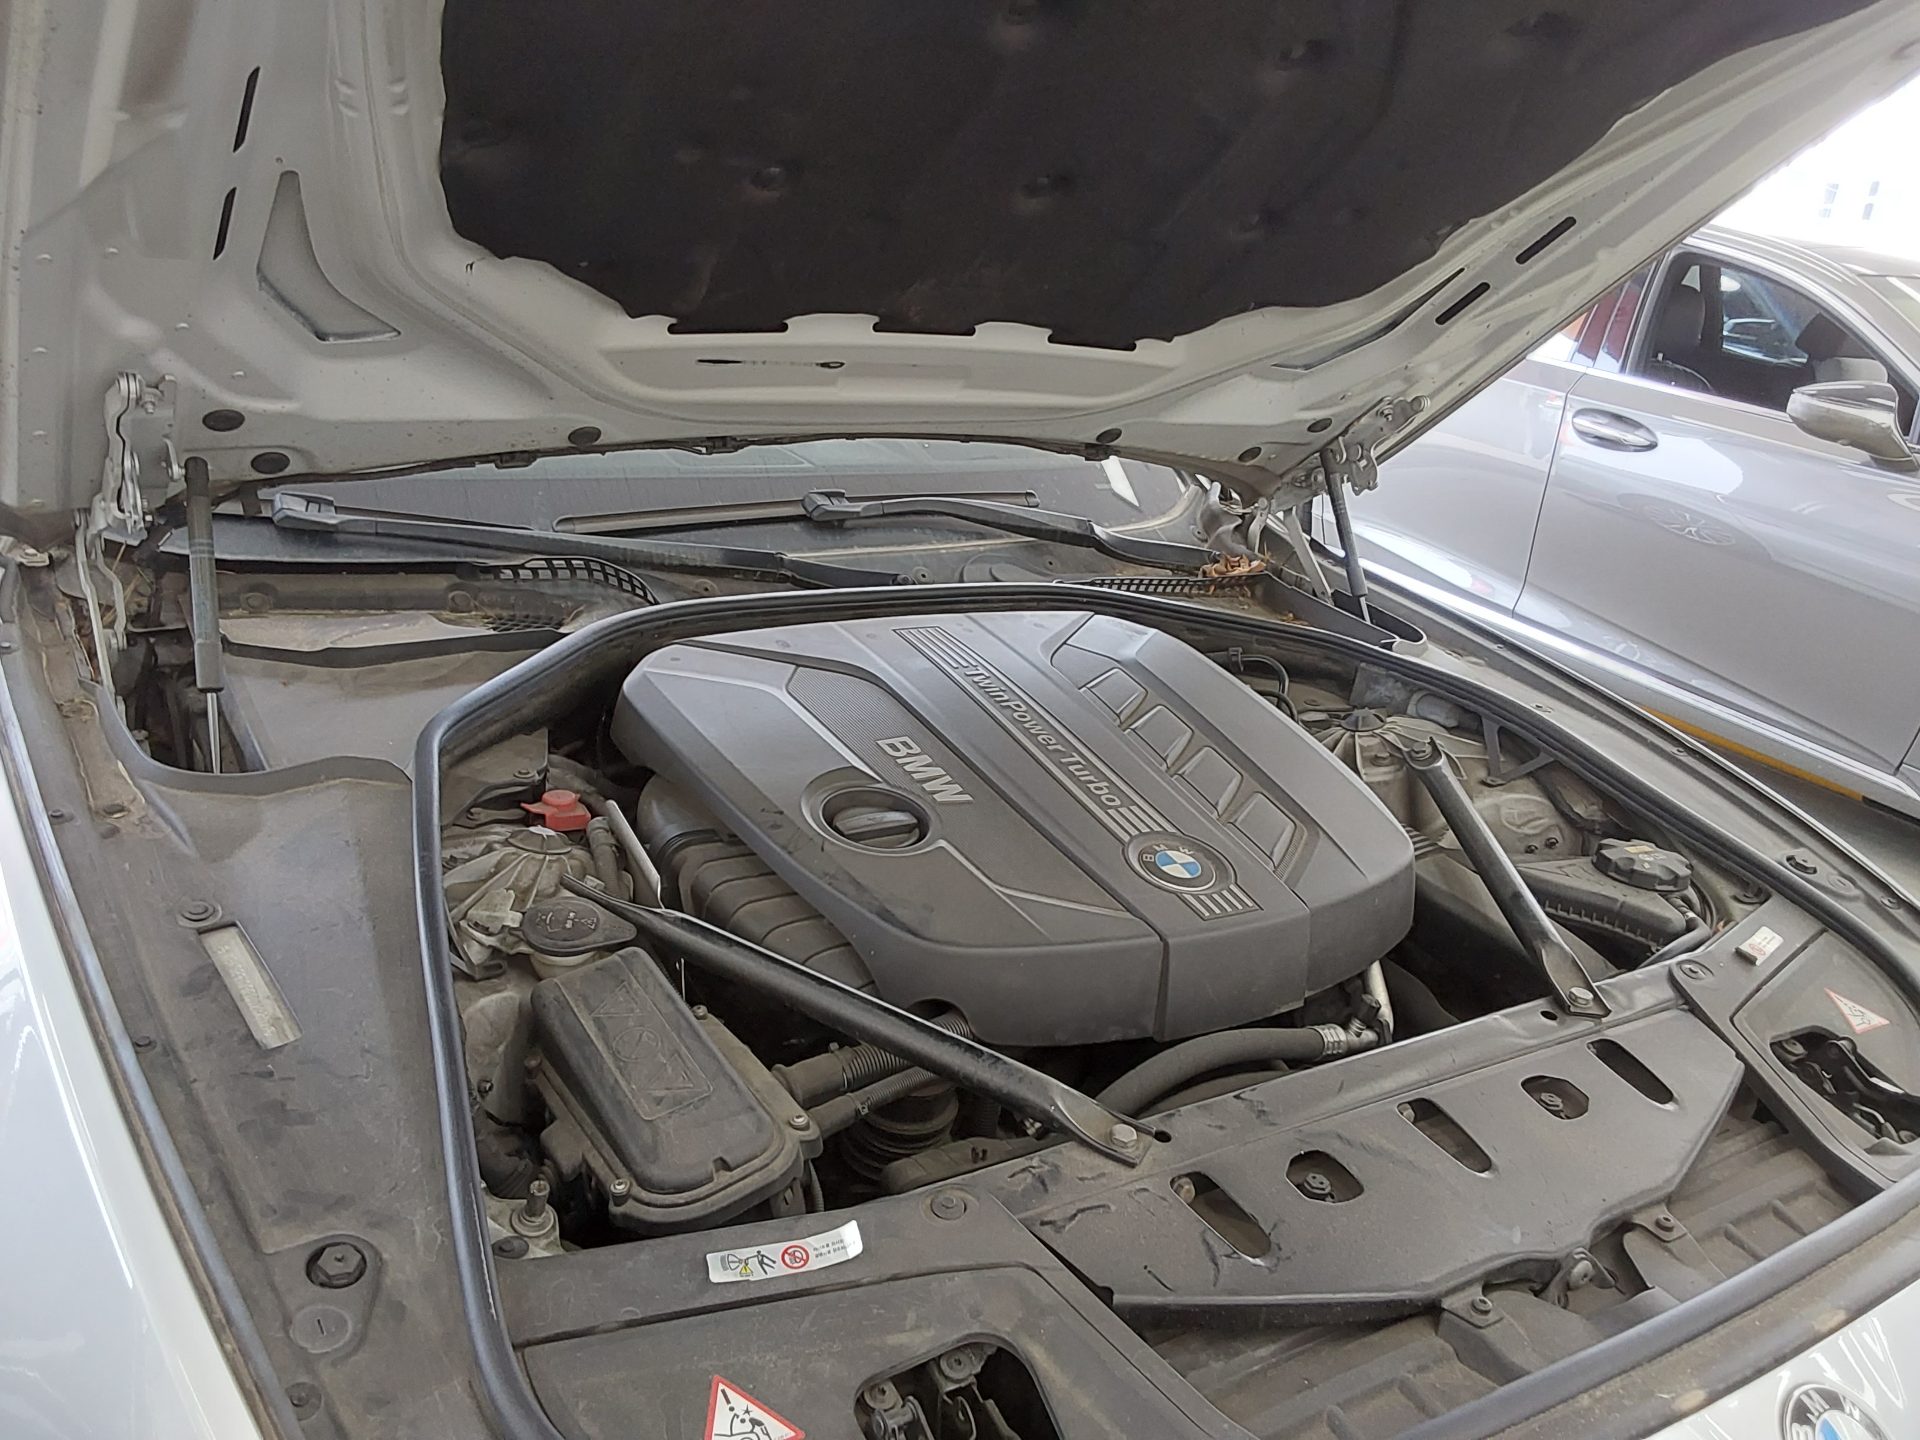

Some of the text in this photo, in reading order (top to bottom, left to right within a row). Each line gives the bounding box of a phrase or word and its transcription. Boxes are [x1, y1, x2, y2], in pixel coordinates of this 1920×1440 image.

[964, 664, 1121, 806] TwinPower Turbo
[875, 736, 974, 802] BMW
[1142, 843, 1195, 862] BMW
